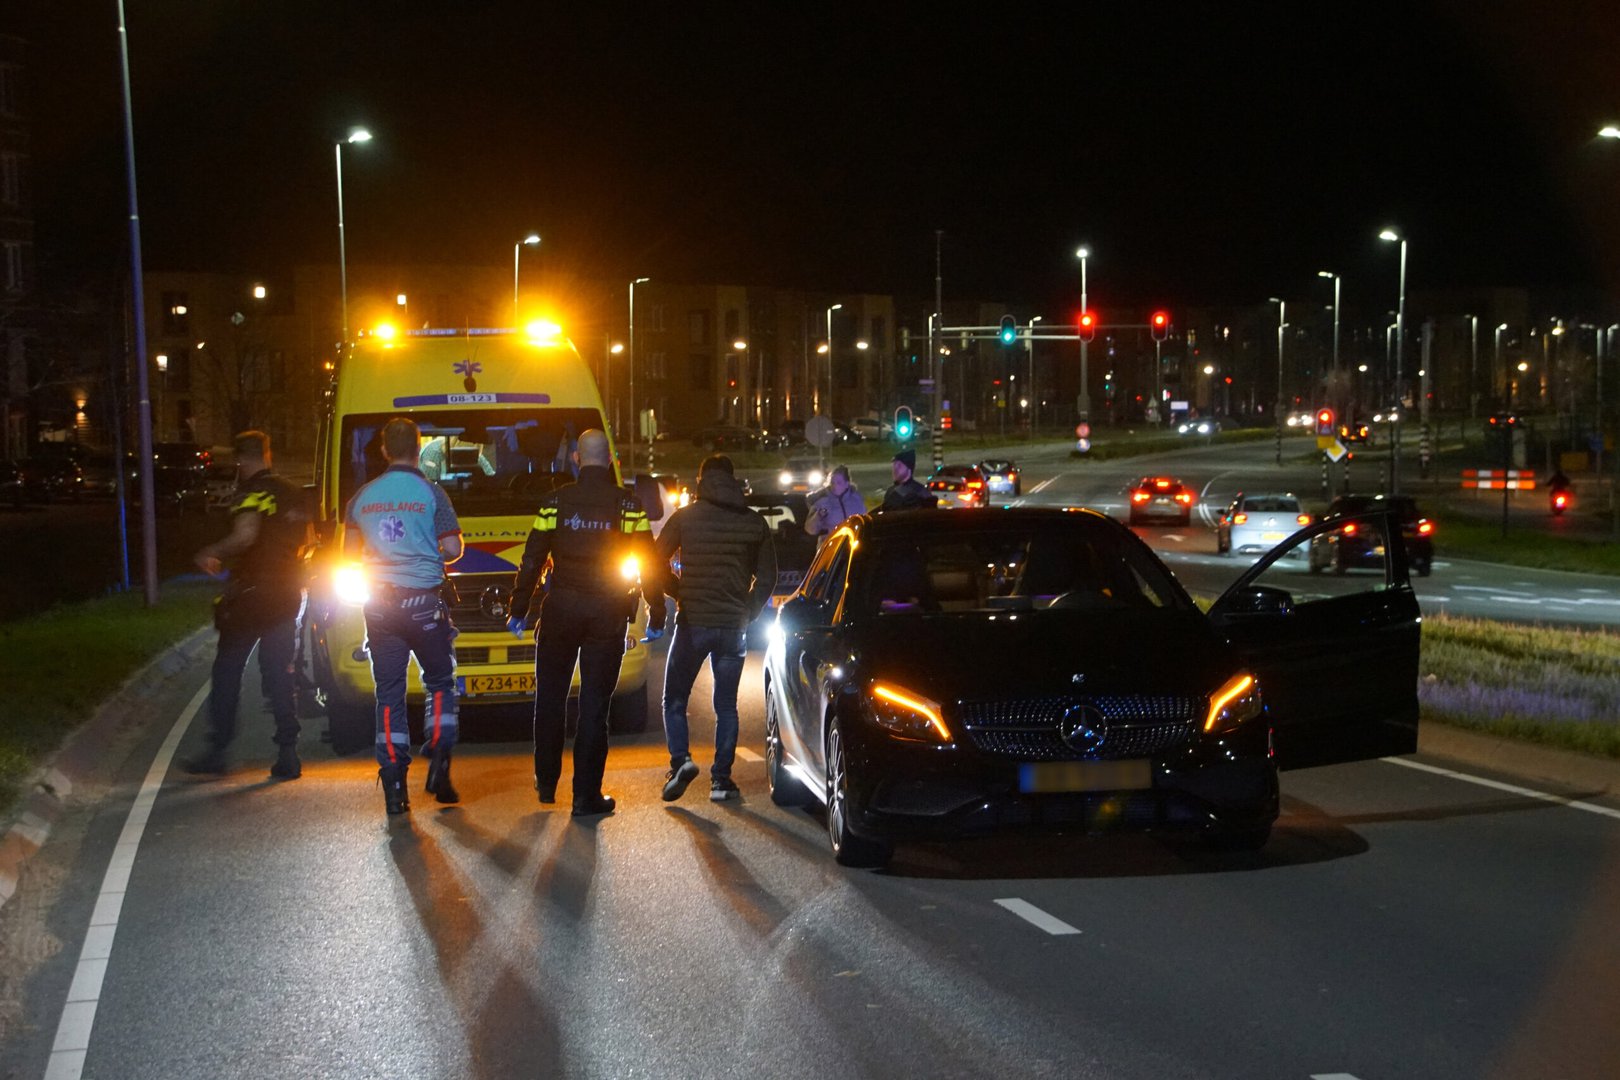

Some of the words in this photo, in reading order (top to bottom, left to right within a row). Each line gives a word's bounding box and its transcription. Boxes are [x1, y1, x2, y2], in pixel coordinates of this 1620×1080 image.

[450, 395, 493, 403] 08-123
[361, 501, 427, 515] AMBULANCE
[563, 512, 612, 531] POLITIE
[462, 530, 527, 538] BULAN
